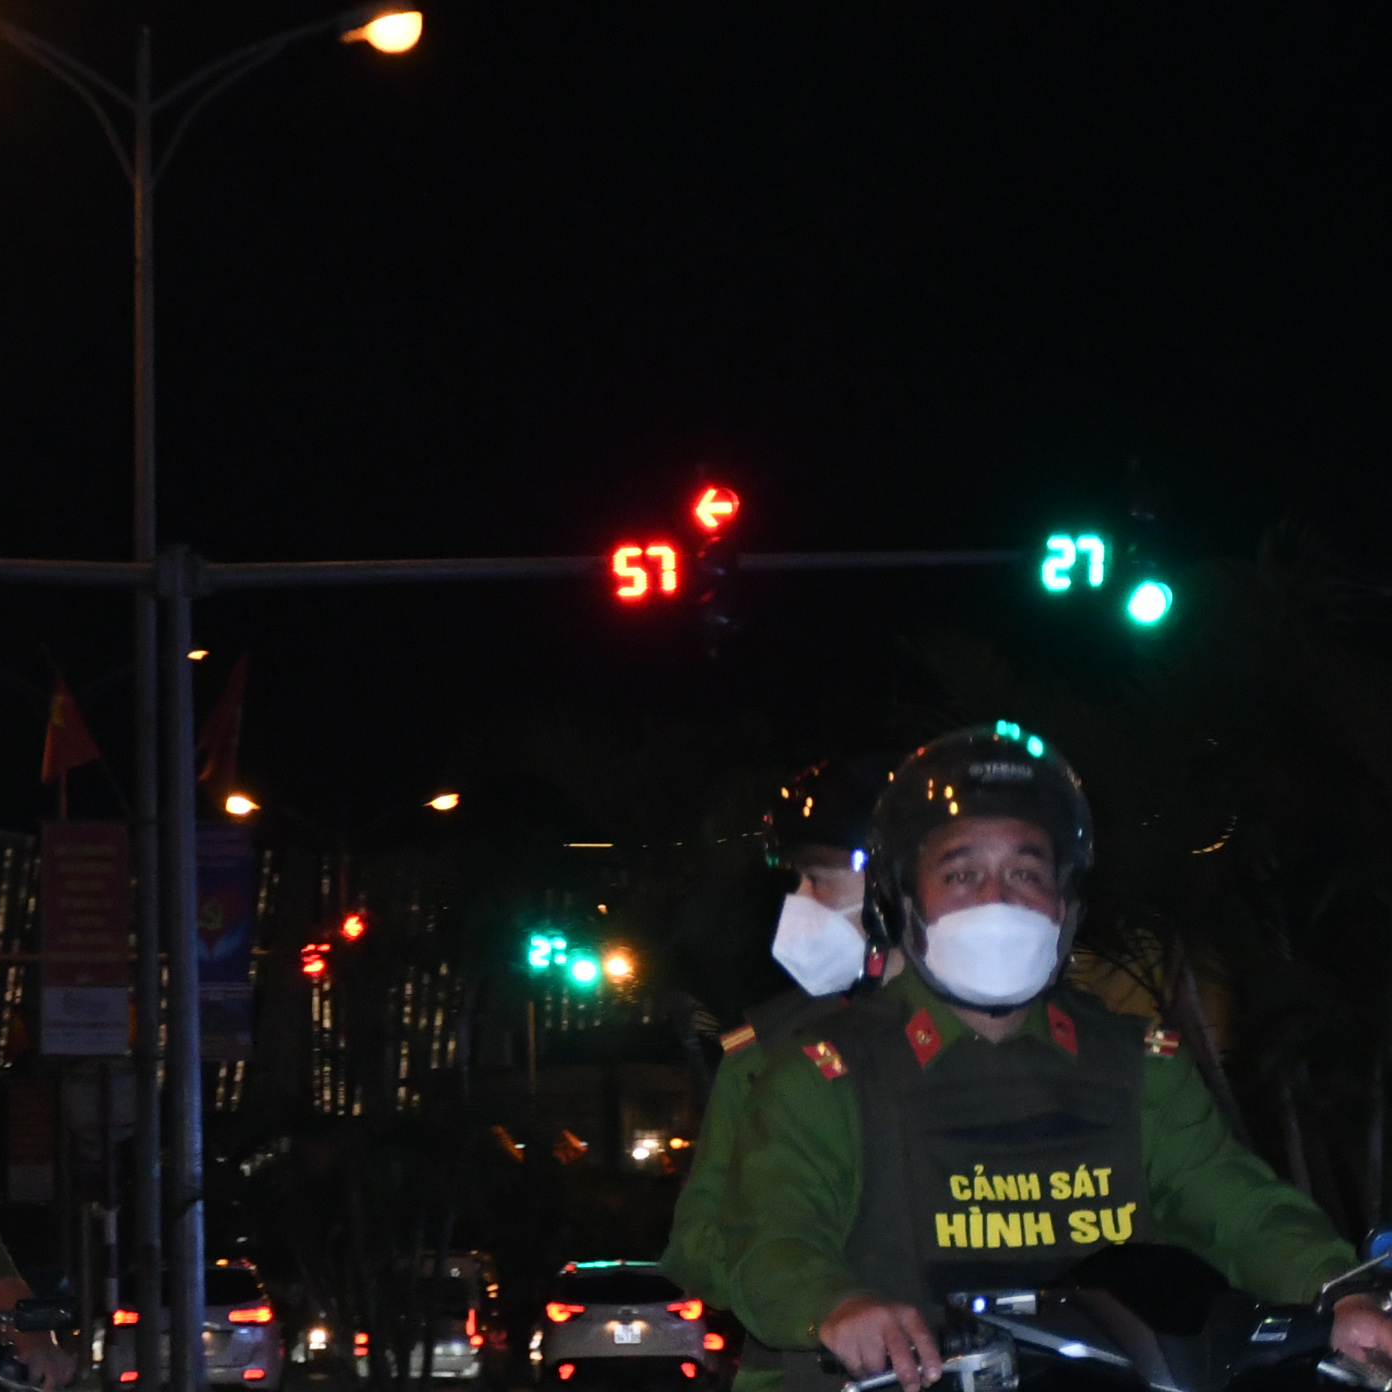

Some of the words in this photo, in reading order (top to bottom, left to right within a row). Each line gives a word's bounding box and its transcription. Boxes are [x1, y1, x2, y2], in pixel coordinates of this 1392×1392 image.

[610, 542, 682, 602] 57
[1041, 533, 1107, 592] 27
[950, 1164, 1041, 1201] CẢNH
[1050, 1164, 1112, 1200] SÁT
[935, 1206, 1056, 1248] HÌNH
[1068, 1202, 1137, 1245] SỰ
